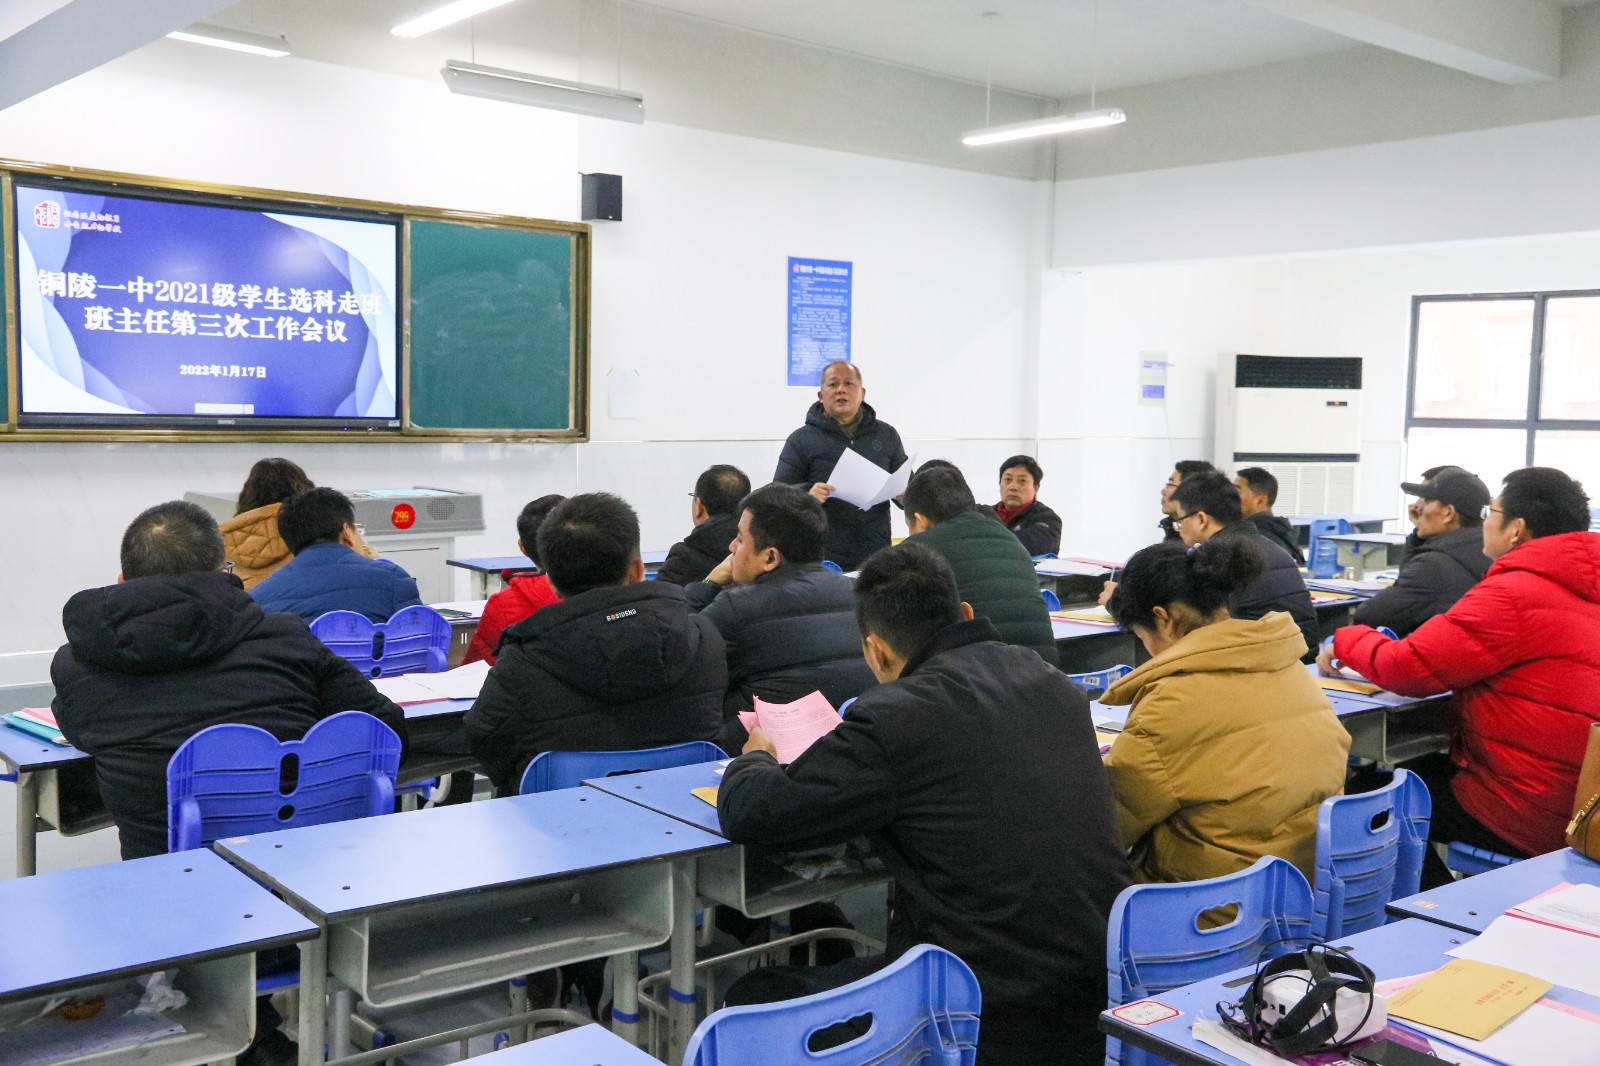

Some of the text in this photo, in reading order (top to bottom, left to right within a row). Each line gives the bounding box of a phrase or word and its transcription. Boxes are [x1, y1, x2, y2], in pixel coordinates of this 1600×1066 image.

[38, 269, 383, 316] 铜陵一中2021级学生选科走班
[84, 306, 348, 343] 班主任第三次工作会议
[179, 364, 267, 378] 2022年1月17日
